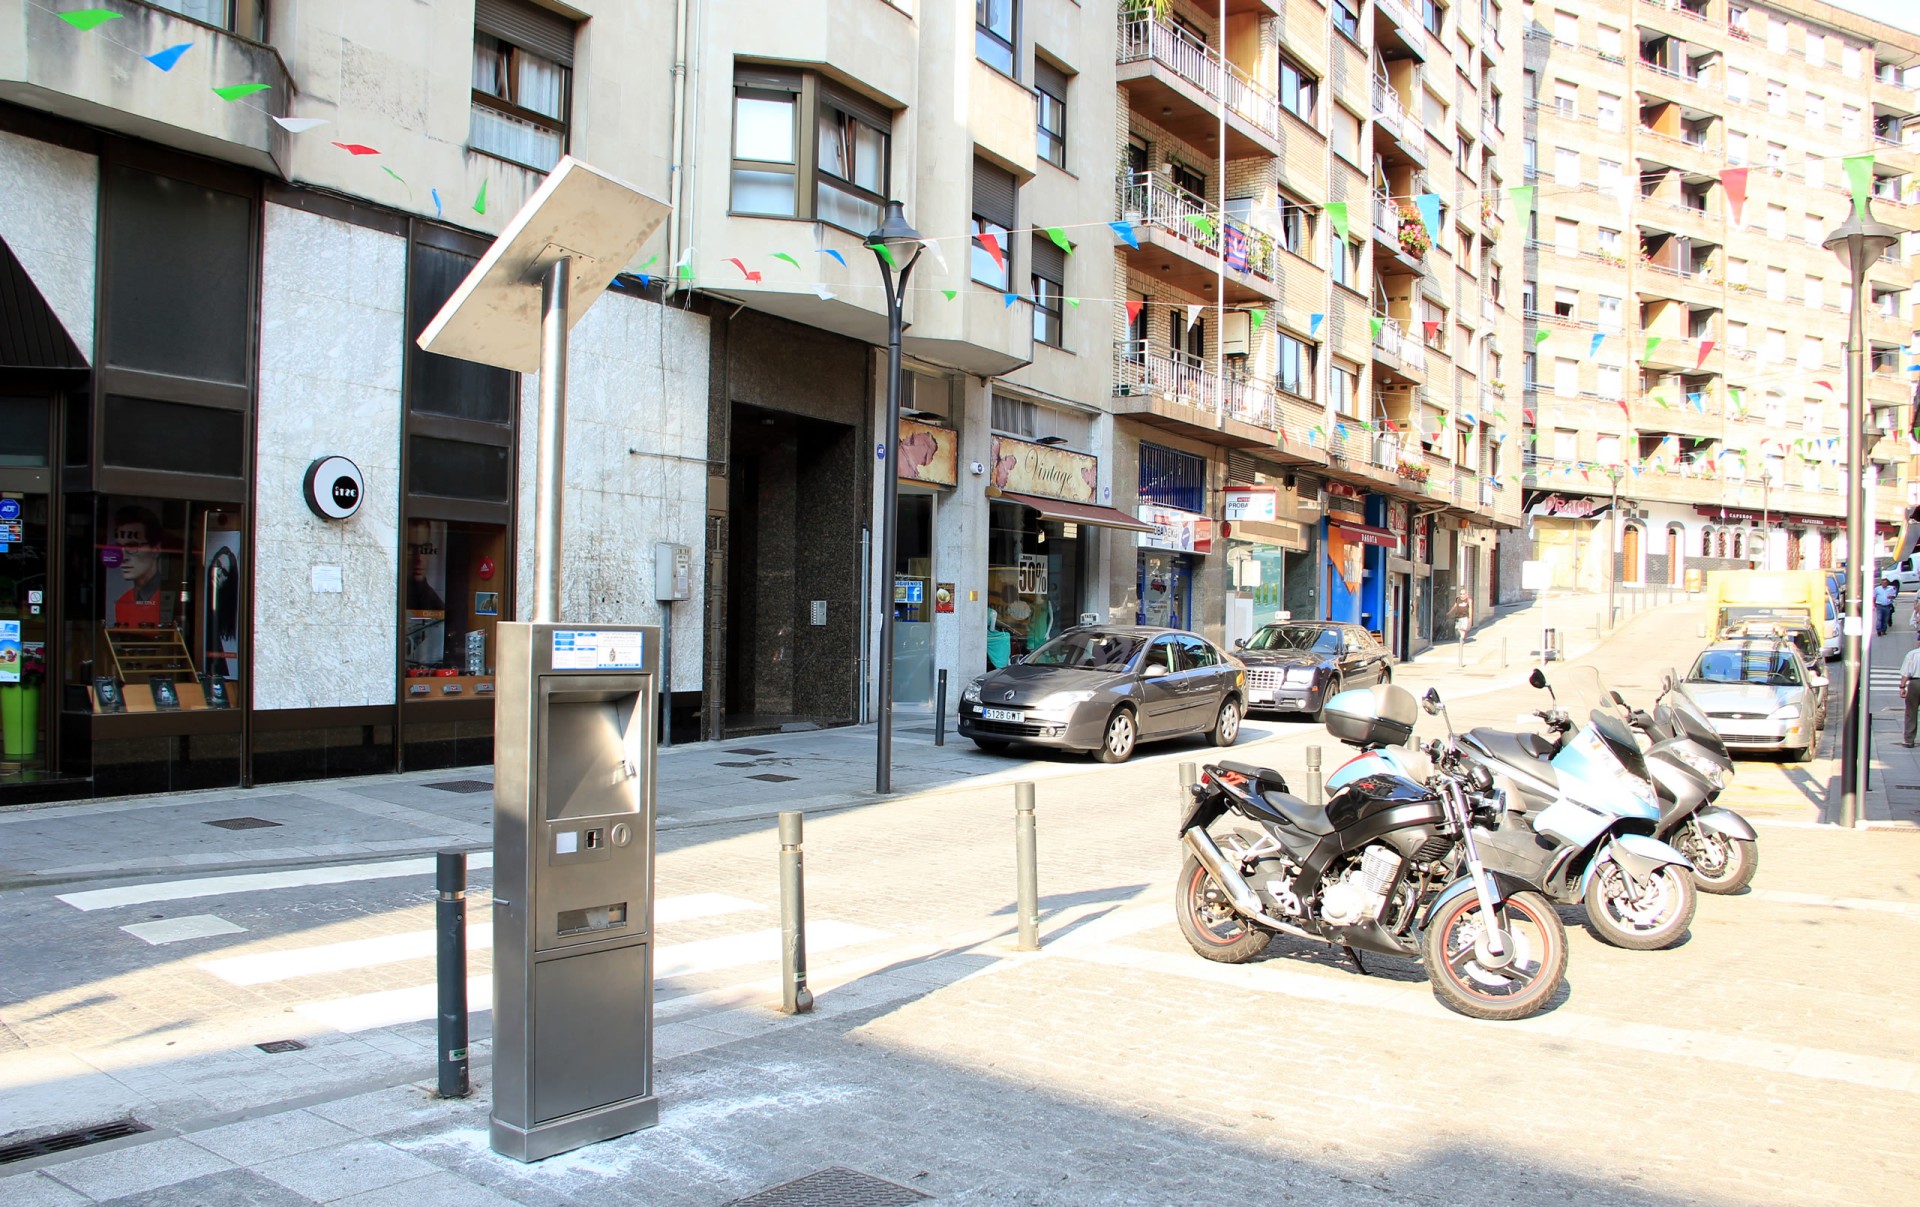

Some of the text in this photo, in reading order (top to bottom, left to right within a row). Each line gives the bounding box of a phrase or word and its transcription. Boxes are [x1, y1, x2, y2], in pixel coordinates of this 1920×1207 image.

[1025, 447, 1073, 495] Vintage
[2, 505, 17, 513] ADT
[1019, 561, 1047, 593] 50%
[986, 709, 1022, 721] 5128 GWT
